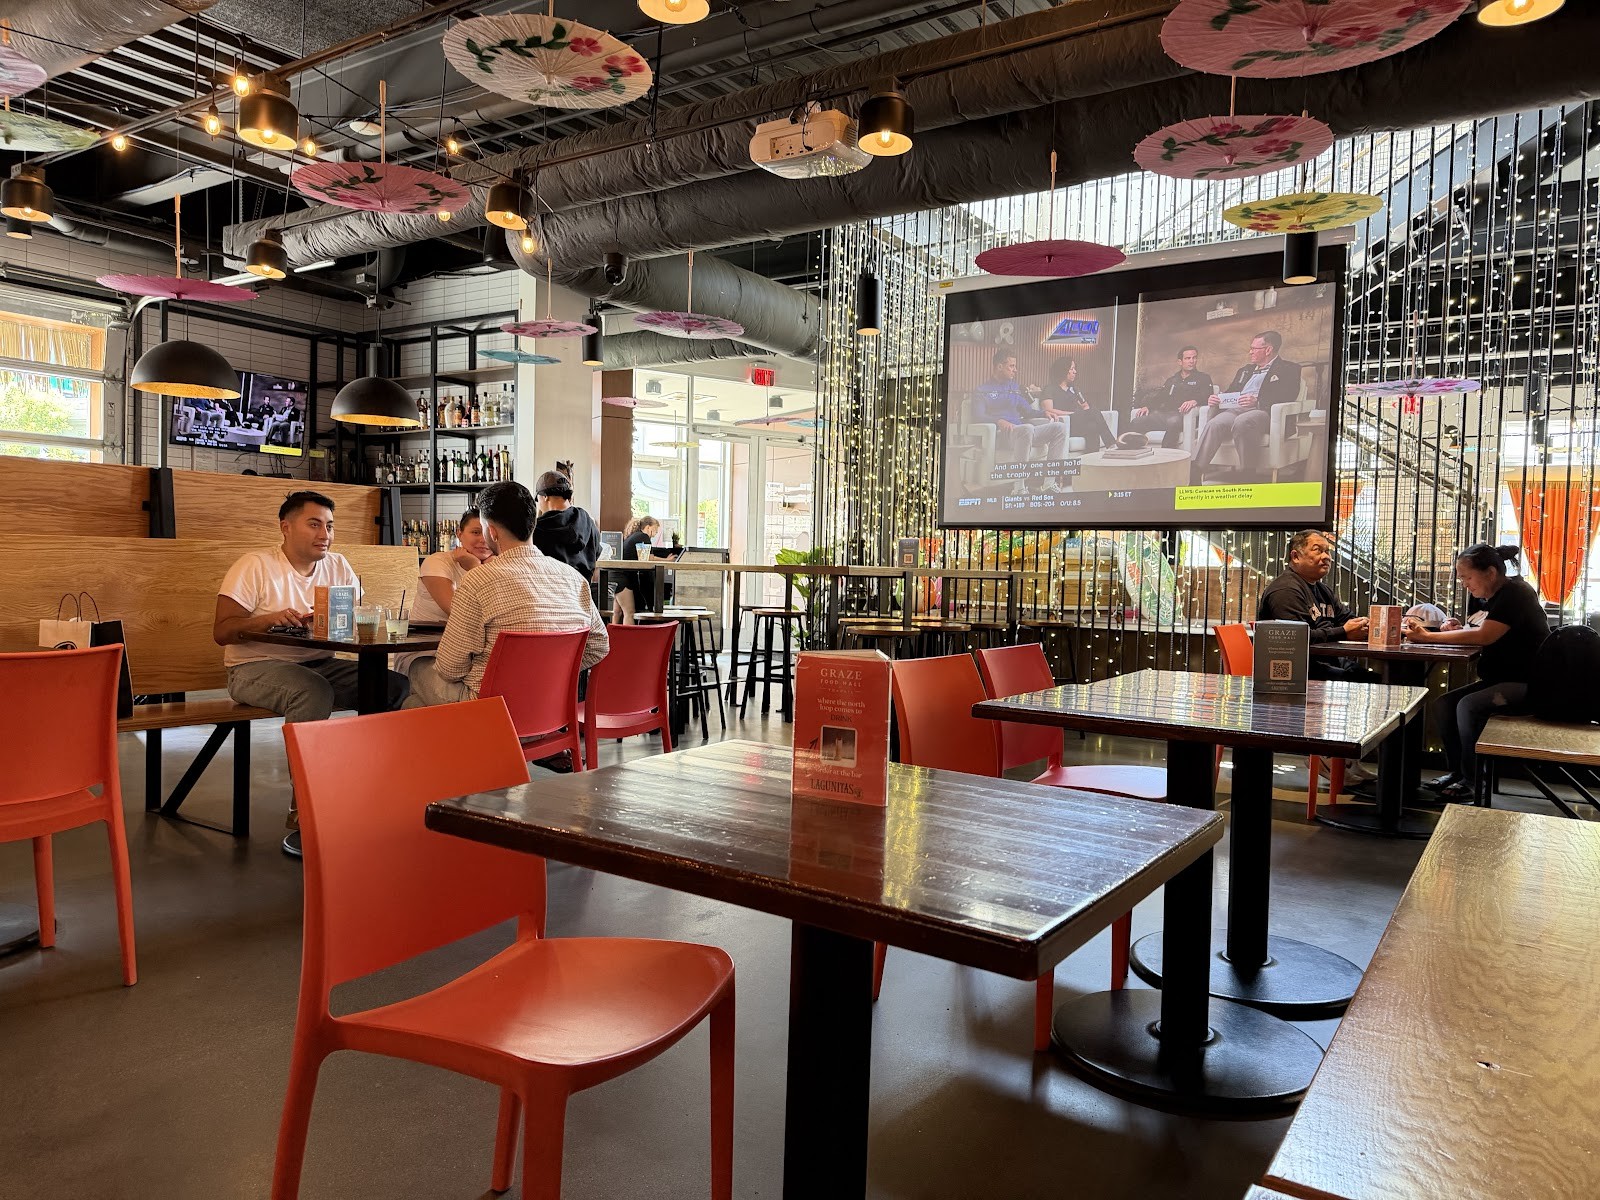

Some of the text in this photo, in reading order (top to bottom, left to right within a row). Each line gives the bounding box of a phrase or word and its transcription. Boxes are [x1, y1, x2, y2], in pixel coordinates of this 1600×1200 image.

[1010, 462, 1027, 472] only
[1006, 471, 1031, 480] trophy
[1031, 494, 1043, 502] Red
[1237, 492, 1253, 500] delay
[958, 498, 982, 506] ESPN
[820, 667, 863, 680] GRAZE
[817, 697, 866, 708] where the north
[819, 703, 834, 713] loop
[834, 706, 855, 714] comes
[830, 713, 853, 723] DRINK
[840, 770, 851, 778] the
[811, 778, 855, 795] LAGUNITAS
